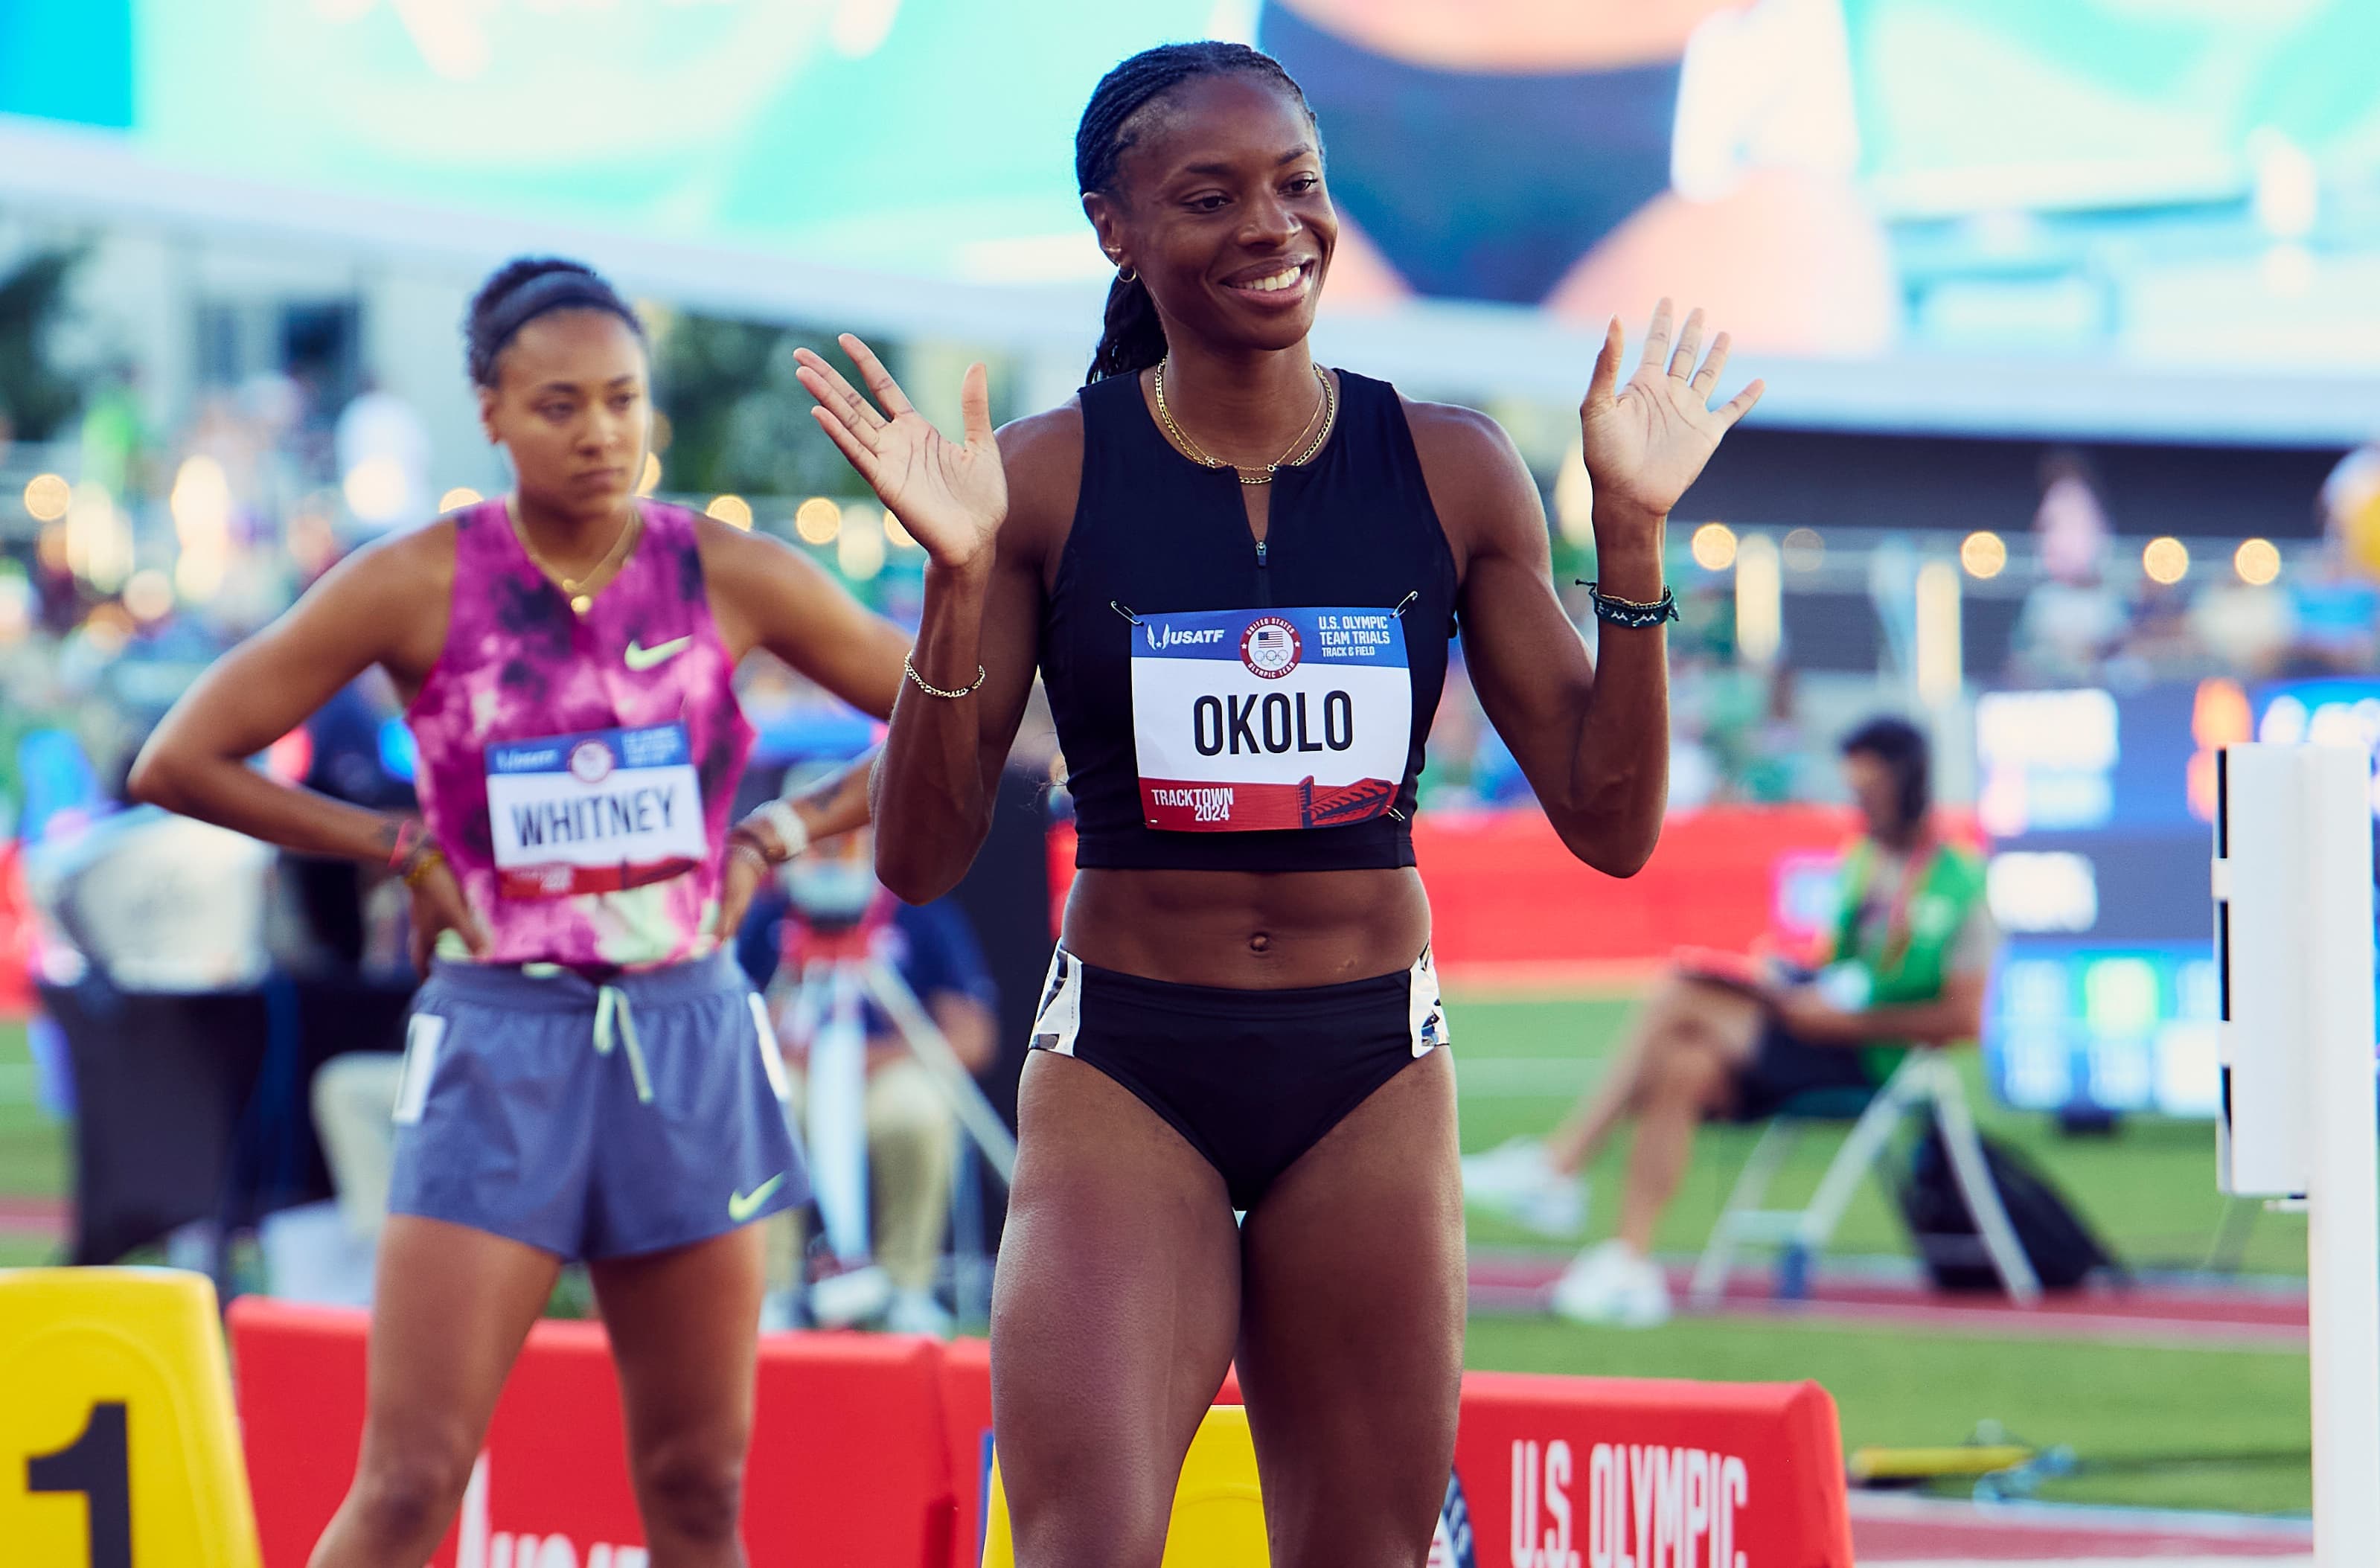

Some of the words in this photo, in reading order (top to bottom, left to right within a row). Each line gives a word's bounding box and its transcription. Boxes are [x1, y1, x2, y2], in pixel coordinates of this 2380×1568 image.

[1246, 618, 1269, 635] UNITED
[1271, 618, 1295, 634] STATES
[1318, 615, 1340, 630] U.S.
[1343, 615, 1388, 630] OLYMPIC
[1171, 630, 1225, 644] USATF
[1319, 631, 1350, 645] TEAM
[1351, 630, 1390, 644] TRIALS
[1322, 647, 1347, 657] TRACK
[1348, 646, 1354, 656] &
[1355, 646, 1375, 656] FIELD
[1248, 662, 1276, 678] OLYMPIC
[1279, 662, 1295, 676] TEAM
[1193, 690, 1353, 757] OKOLO
[1151, 787, 1234, 807] TRACKTOWN
[510, 784, 675, 848] WHITNEY
[1194, 804, 1230, 822] 2024
[25, 1399, 135, 1568] 1
[1511, 1439, 1581, 1568] U.S.
[1589, 1442, 1747, 1568] OLYMPIC
